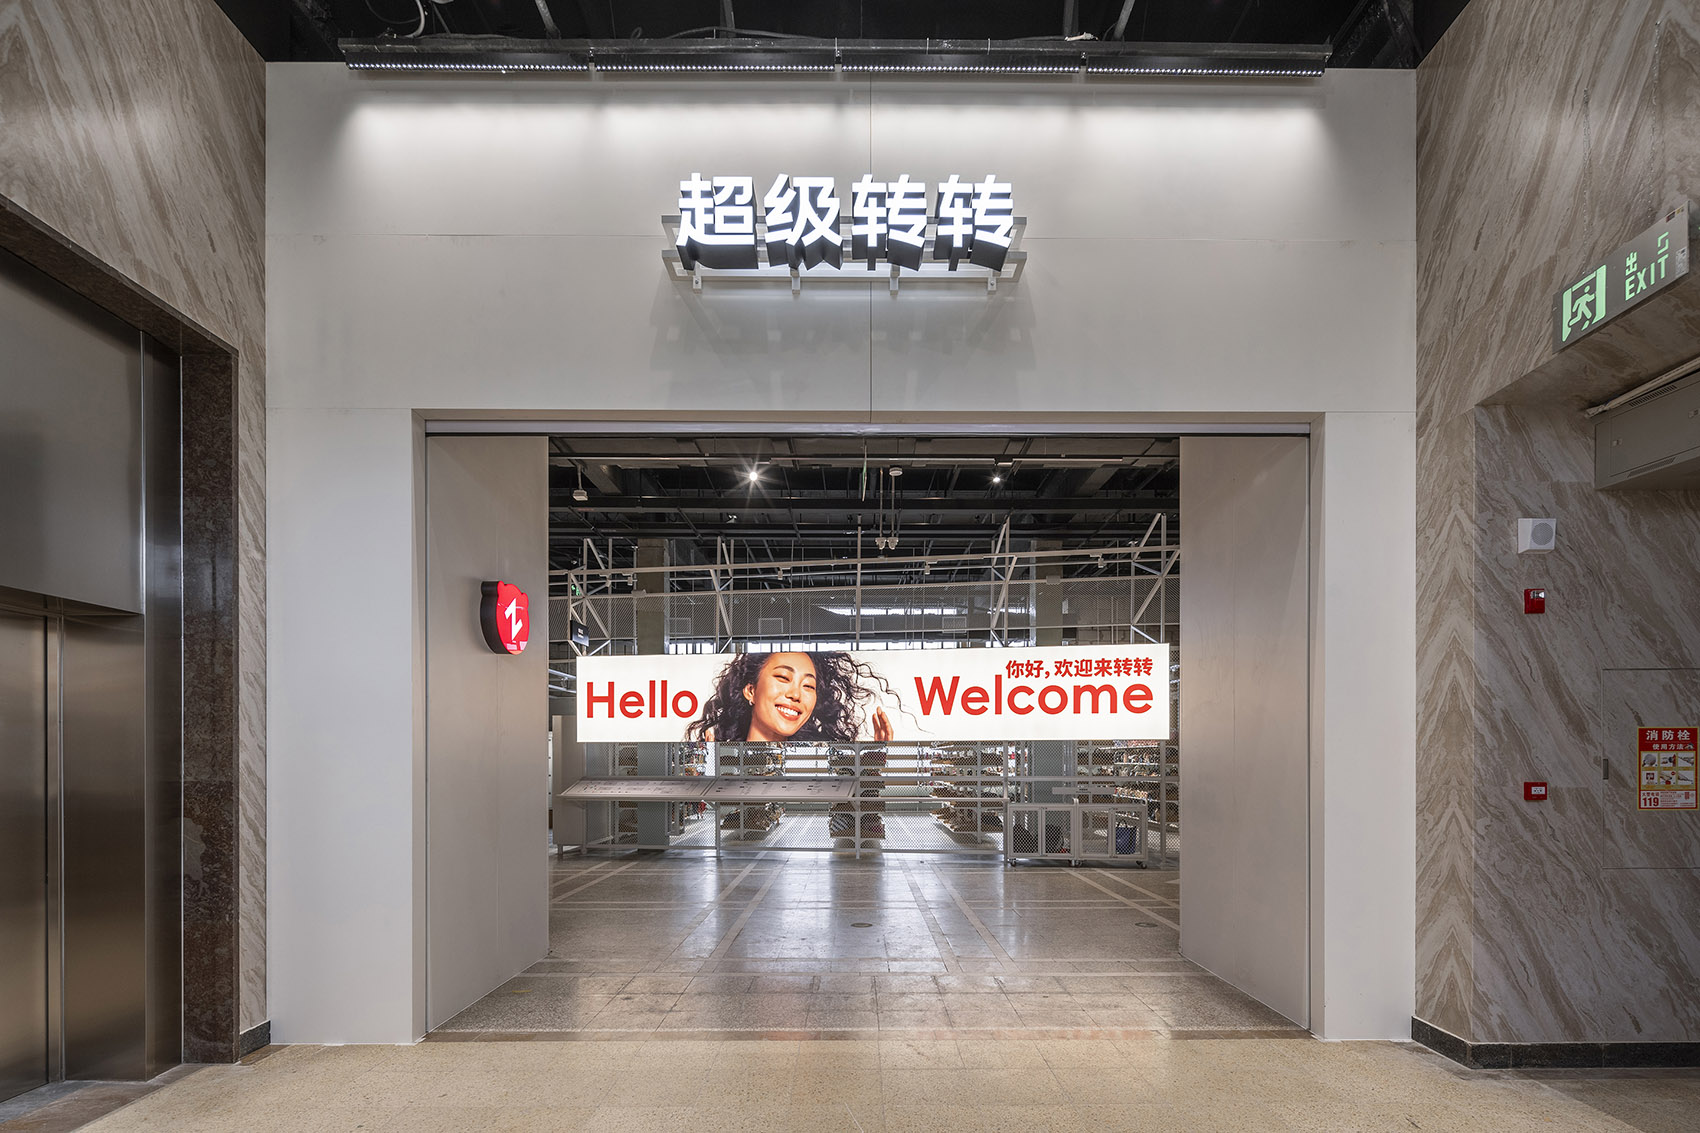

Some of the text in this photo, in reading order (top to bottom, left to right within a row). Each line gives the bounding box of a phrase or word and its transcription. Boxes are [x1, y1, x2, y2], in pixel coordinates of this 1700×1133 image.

[676, 173, 1014, 248] 超级转转
[1625, 231, 1669, 276] 出口
[1625, 253, 1669, 301] EXIT
[586, 680, 698, 719] Hello
[915, 675, 1154, 716] Welcome
[1646, 729, 1691, 741] 消防栓
[1642, 797, 1660, 807] 119
